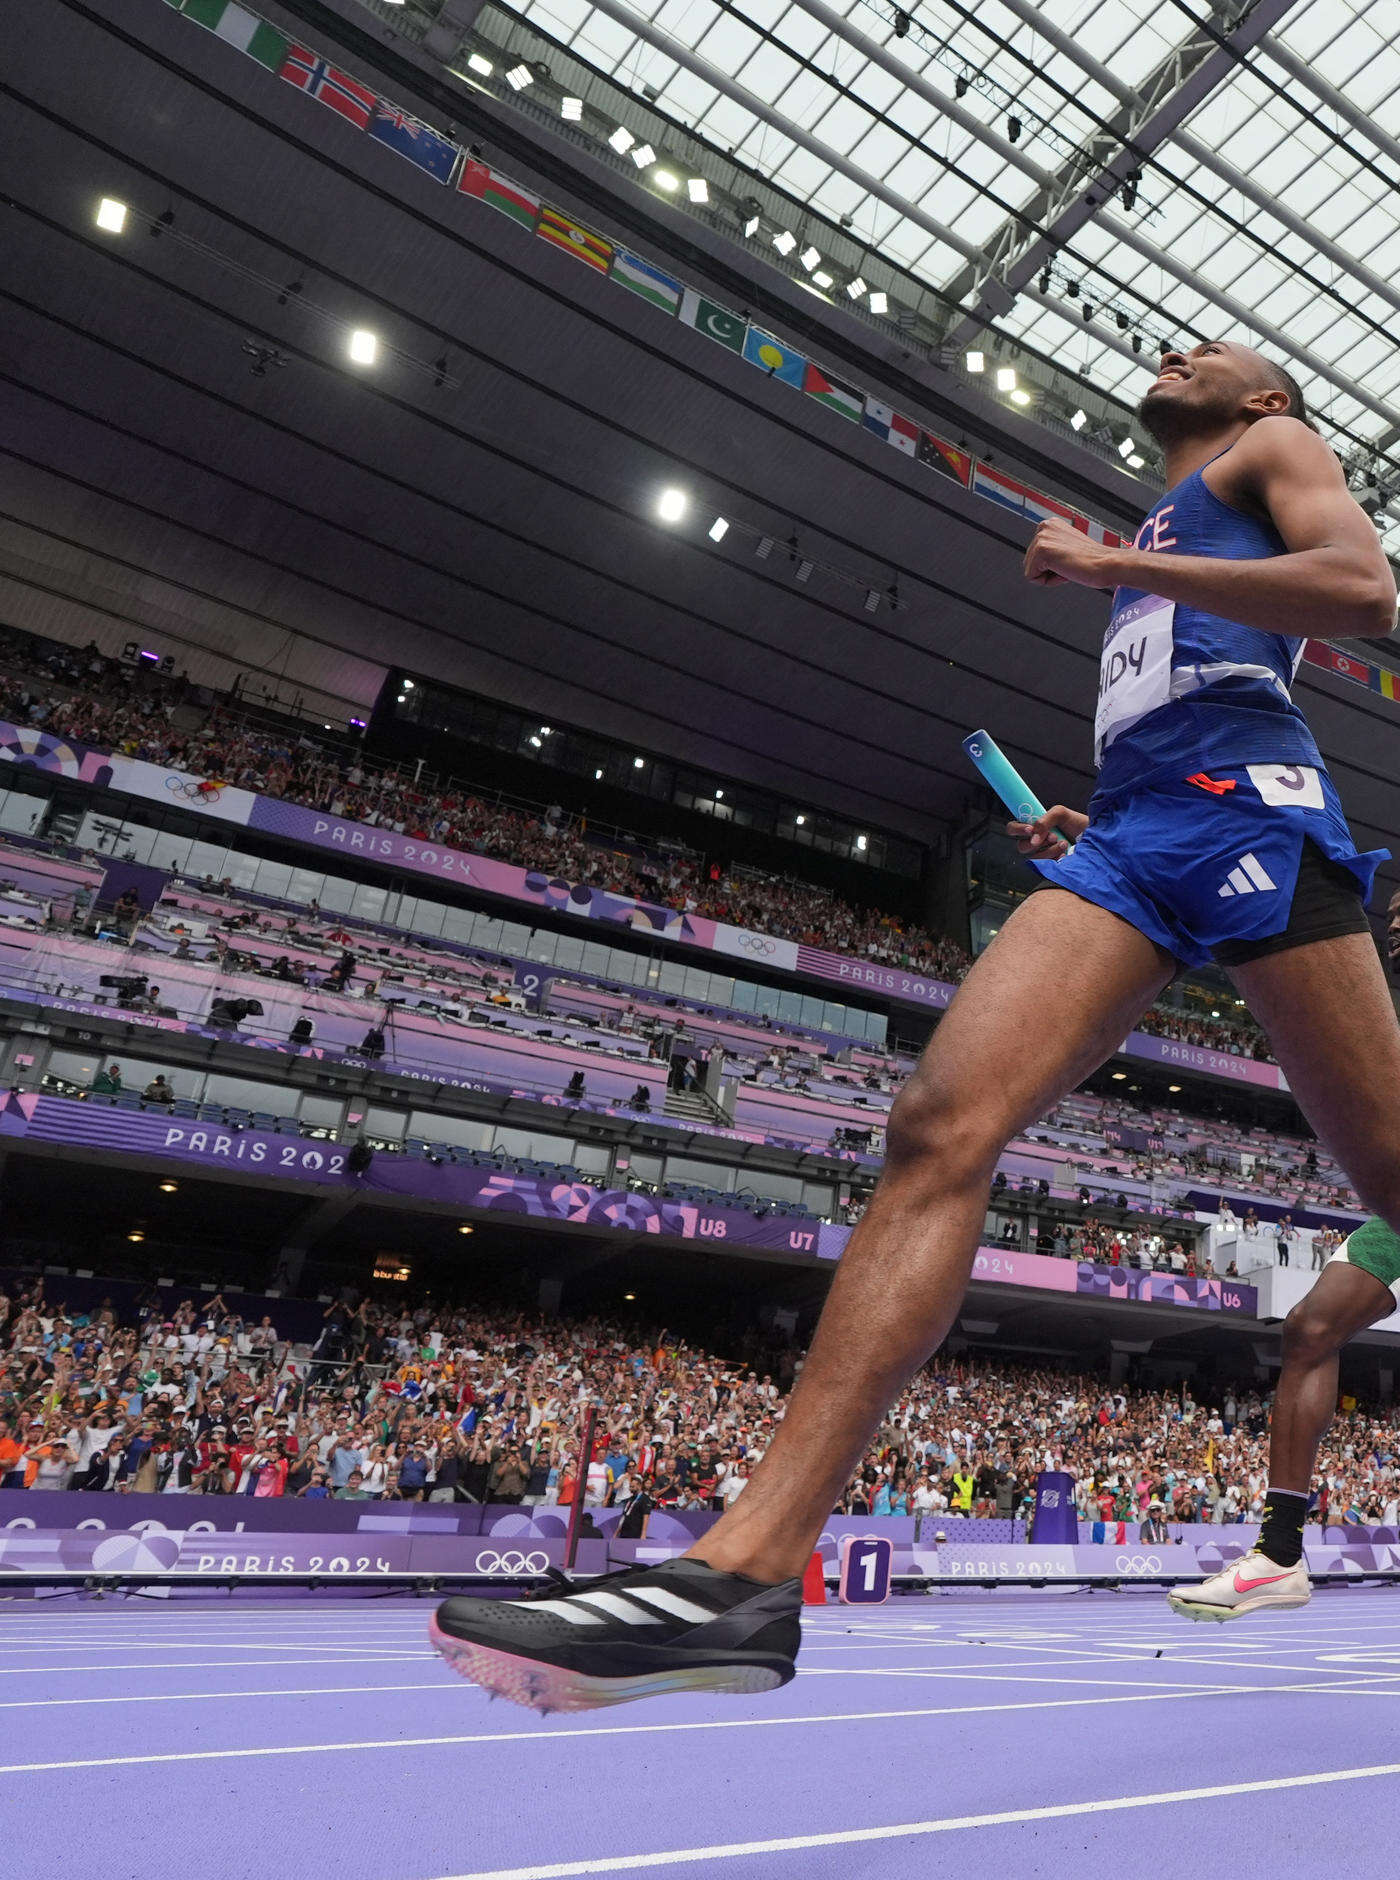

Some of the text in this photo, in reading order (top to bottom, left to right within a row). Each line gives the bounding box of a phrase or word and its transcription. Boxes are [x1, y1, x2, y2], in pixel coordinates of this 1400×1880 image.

[1100, 636, 1147, 699] IDY
[969, 743, 983, 757] 3
[313, 820, 472, 875] PARIS 2024
[523, 974, 540, 996] 2
[839, 963, 949, 1002] PARIS 2024
[1161, 1044, 1248, 1075] PARIS 2024
[164, 1127, 345, 1175] PARIS 202
[700, 1218, 727, 1238] U8
[789, 1231, 815, 1250] U7
[975, 1255, 1015, 1275] 024
[1223, 1292, 1241, 1308] U6
[199, 1555, 391, 1574] PARIS 2024
[859, 1551, 878, 1591] 1
[951, 1560, 1066, 1576] PARIS 2024
